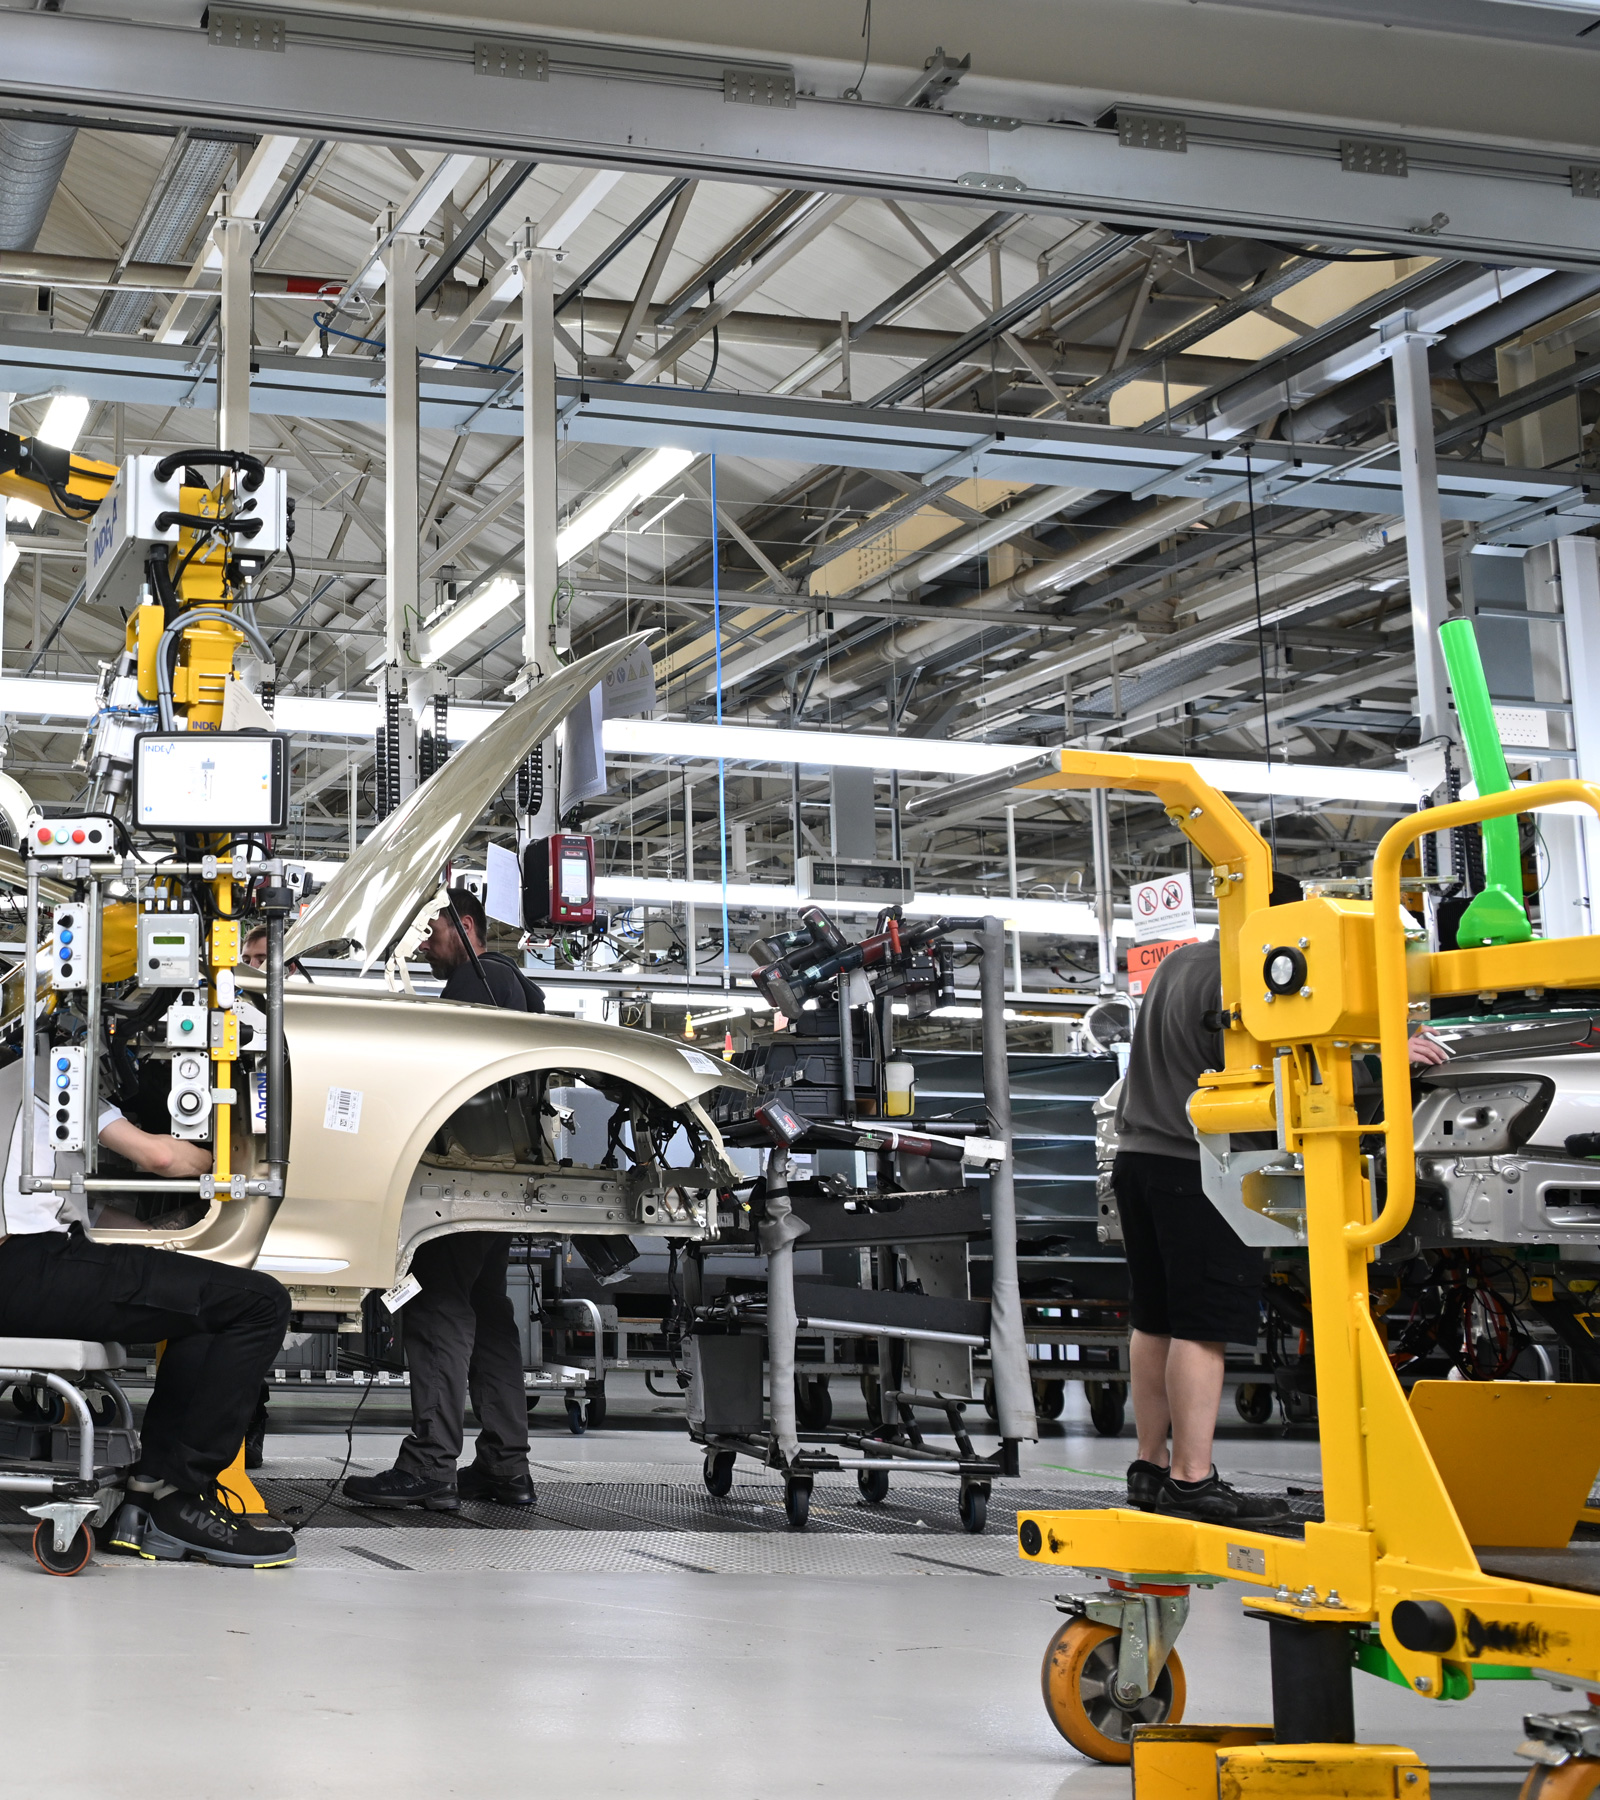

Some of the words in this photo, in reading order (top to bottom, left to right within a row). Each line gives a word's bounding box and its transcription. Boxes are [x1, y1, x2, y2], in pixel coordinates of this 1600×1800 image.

[94, 495, 118, 568] INDEVA
[192, 720, 222, 731] INDEV
[145, 743, 175, 754] INDEVA
[180, 1503, 238, 1546] uvex
